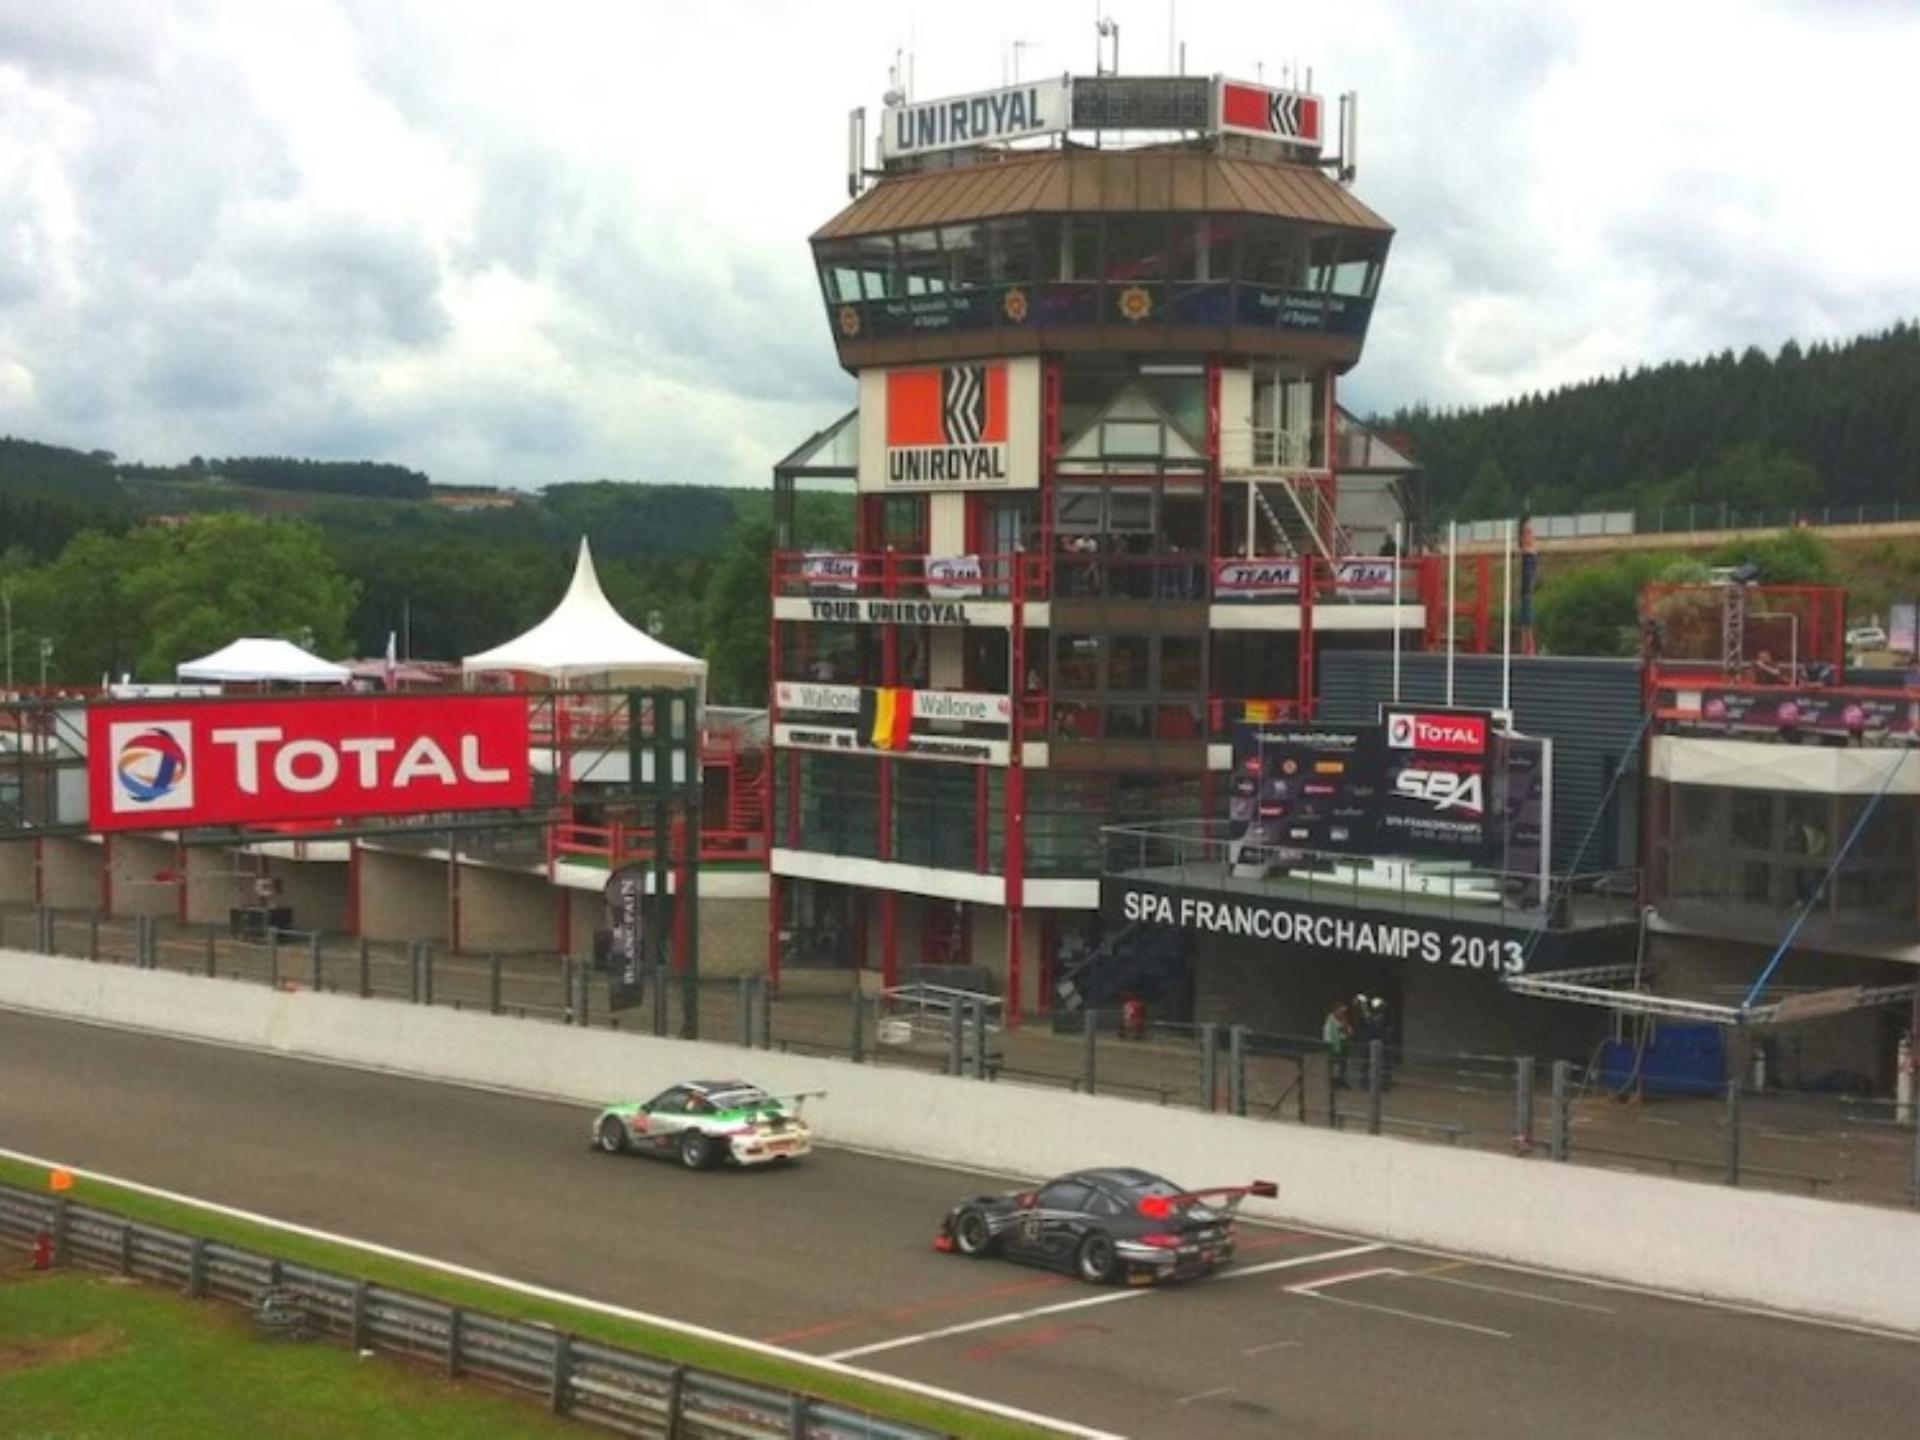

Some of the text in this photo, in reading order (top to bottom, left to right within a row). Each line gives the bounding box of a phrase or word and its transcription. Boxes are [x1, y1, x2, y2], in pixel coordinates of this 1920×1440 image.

[898, 88, 1045, 150] UNIROYAL
[889, 446, 1005, 482] UNIROYAL
[1235, 567, 1292, 582] TEAM
[810, 600, 970, 625] TOUR UNIROYAL
[920, 694, 987, 718] Wallonie
[1416, 722, 1480, 745] TOTAL
[211, 726, 510, 795] TOTAL
[1390, 768, 1484, 813] SPA
[1420, 877, 1429, 892] 2
[1124, 890, 1525, 974] SPA FRANCORCHAMPS 2013
